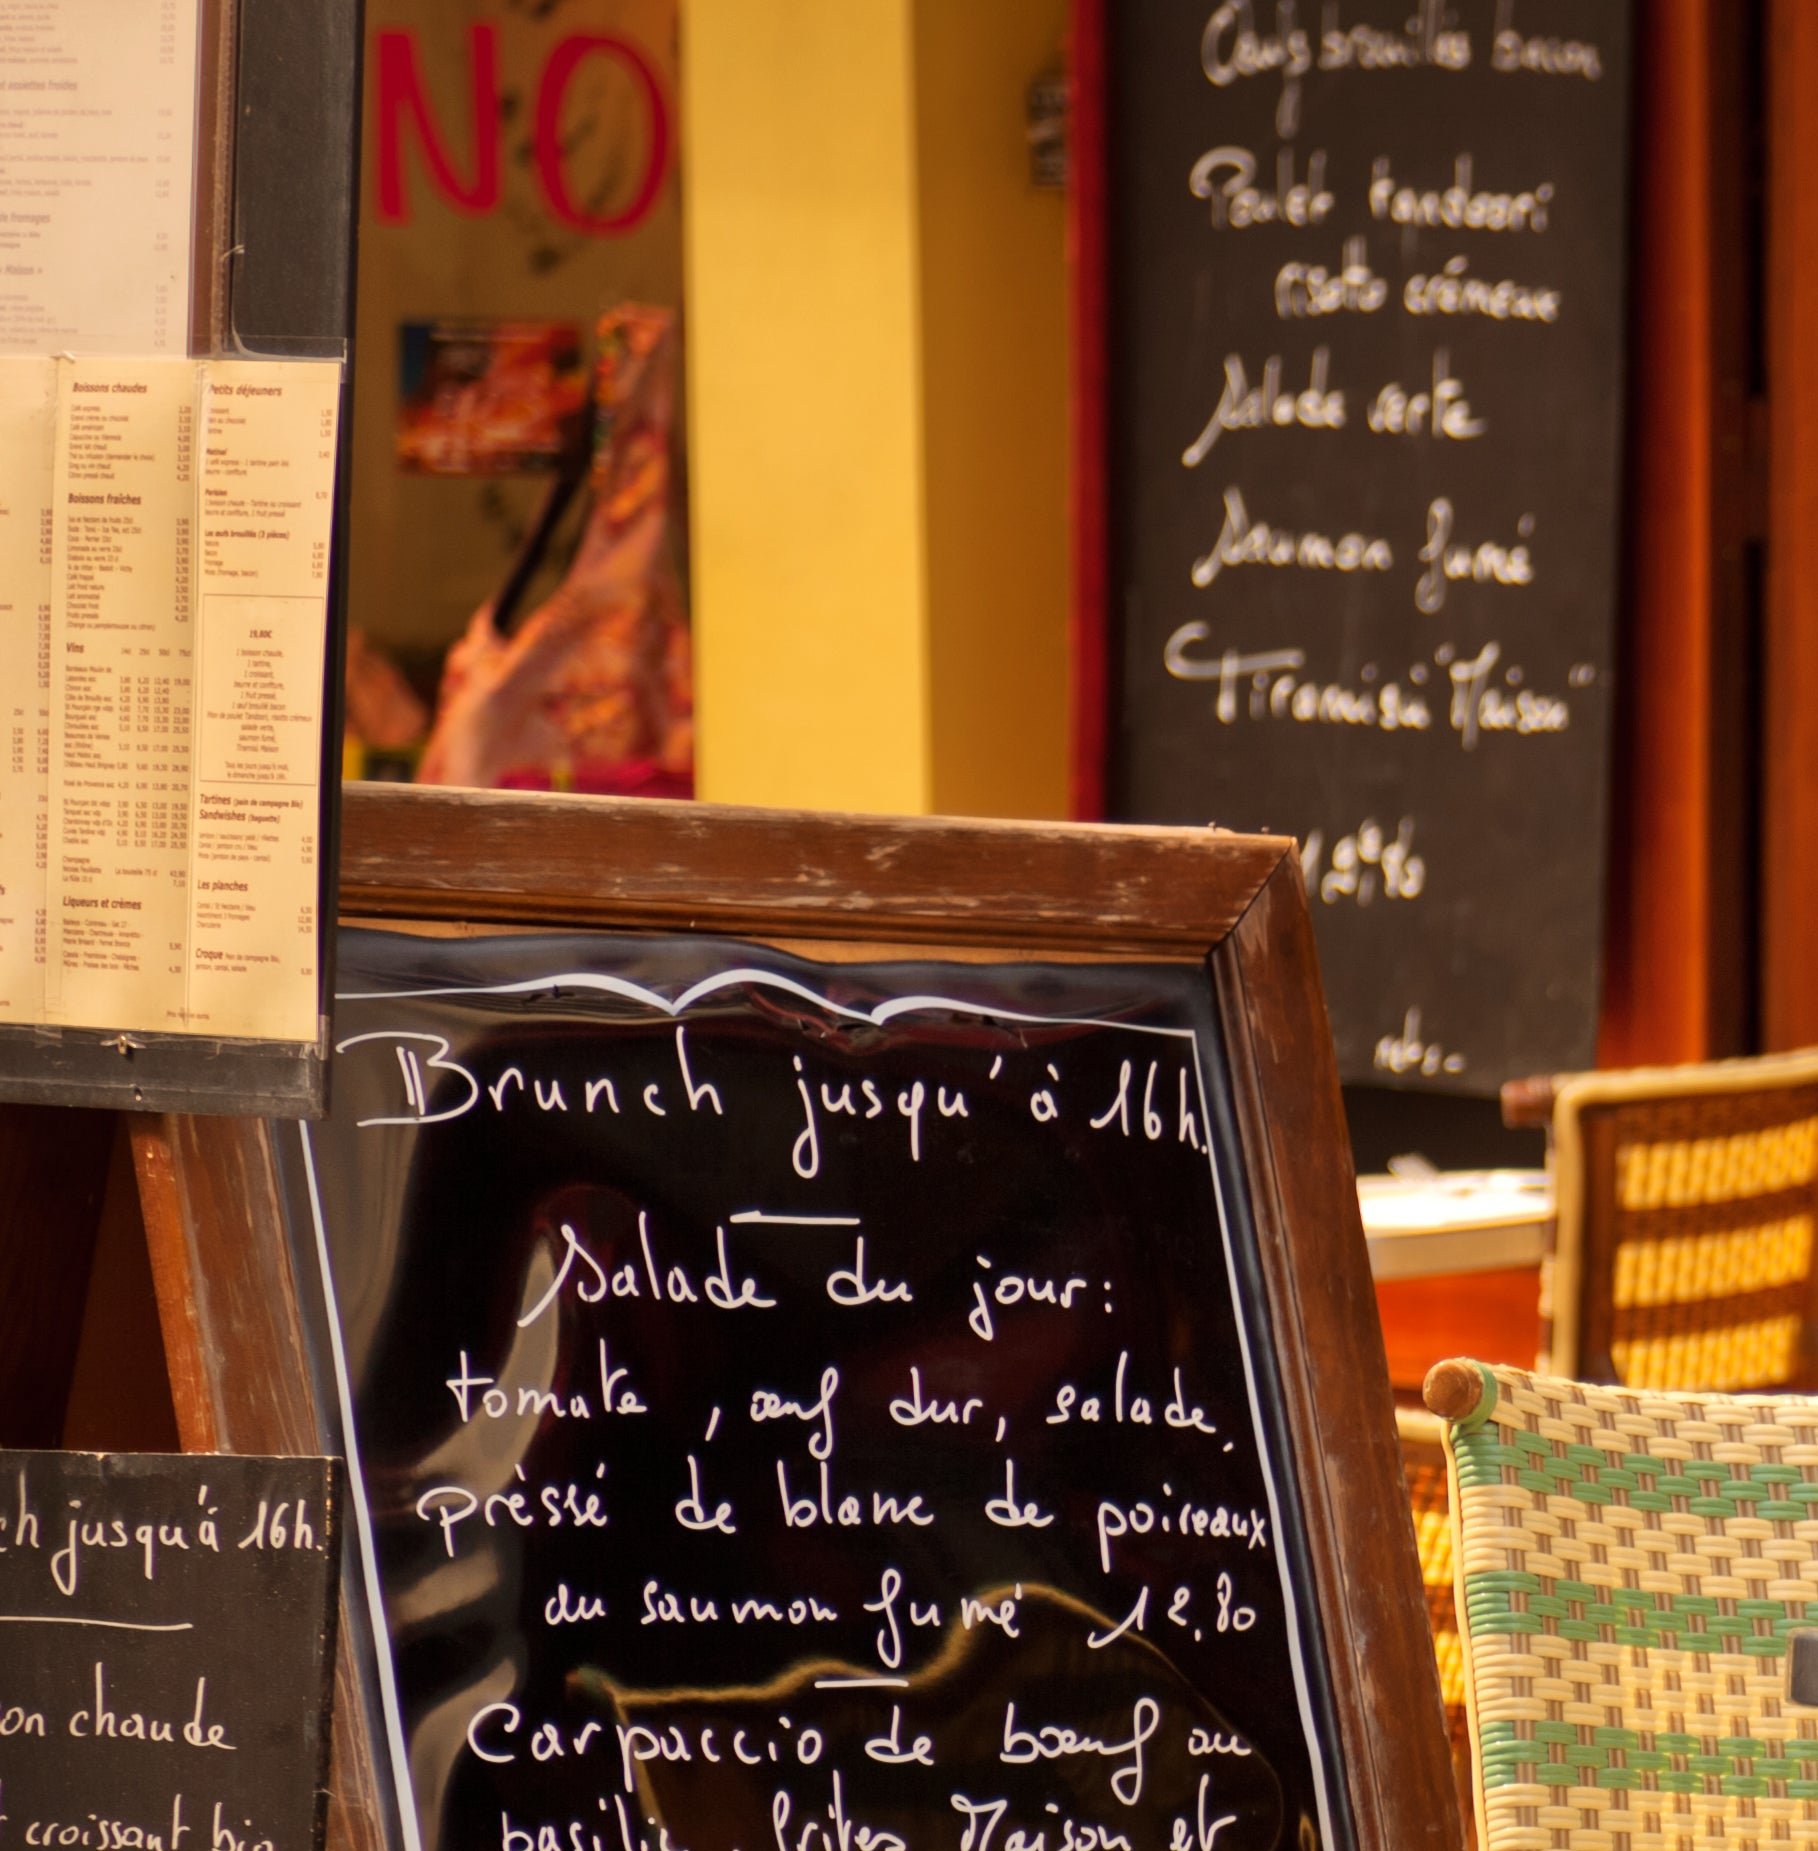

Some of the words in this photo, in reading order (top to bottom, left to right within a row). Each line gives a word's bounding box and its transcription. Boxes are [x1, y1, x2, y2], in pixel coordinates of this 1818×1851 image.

[374, 24, 672, 236] NO
[68, 492, 105, 504] Boissons
[66, 642, 85, 653] Vins
[62, 896, 98, 909] Liqueurs
[100, 898, 110, 908] et
[335, 1025, 723, 1127] Brunch
[517, 1211, 777, 1328] Salade
[826, 1236, 913, 1305] du
[968, 1255, 1112, 1341] jour:
[675, 1454, 737, 1534] de
[776, 1460, 934, 1527] blanc
[985, 1458, 1054, 1527] de
[1097, 1483, 1266, 1573] poireaux
[545, 1583, 606, 1625] du
[640, 1580, 838, 1625] saumon
[863, 1568, 1022, 1668] fumé
[69, 1661, 237, 1750] chaude
[467, 1702, 823, 1793] Carpaccio
[864, 1705, 934, 1766] de
[1188, 1728, 1252, 1756] au
